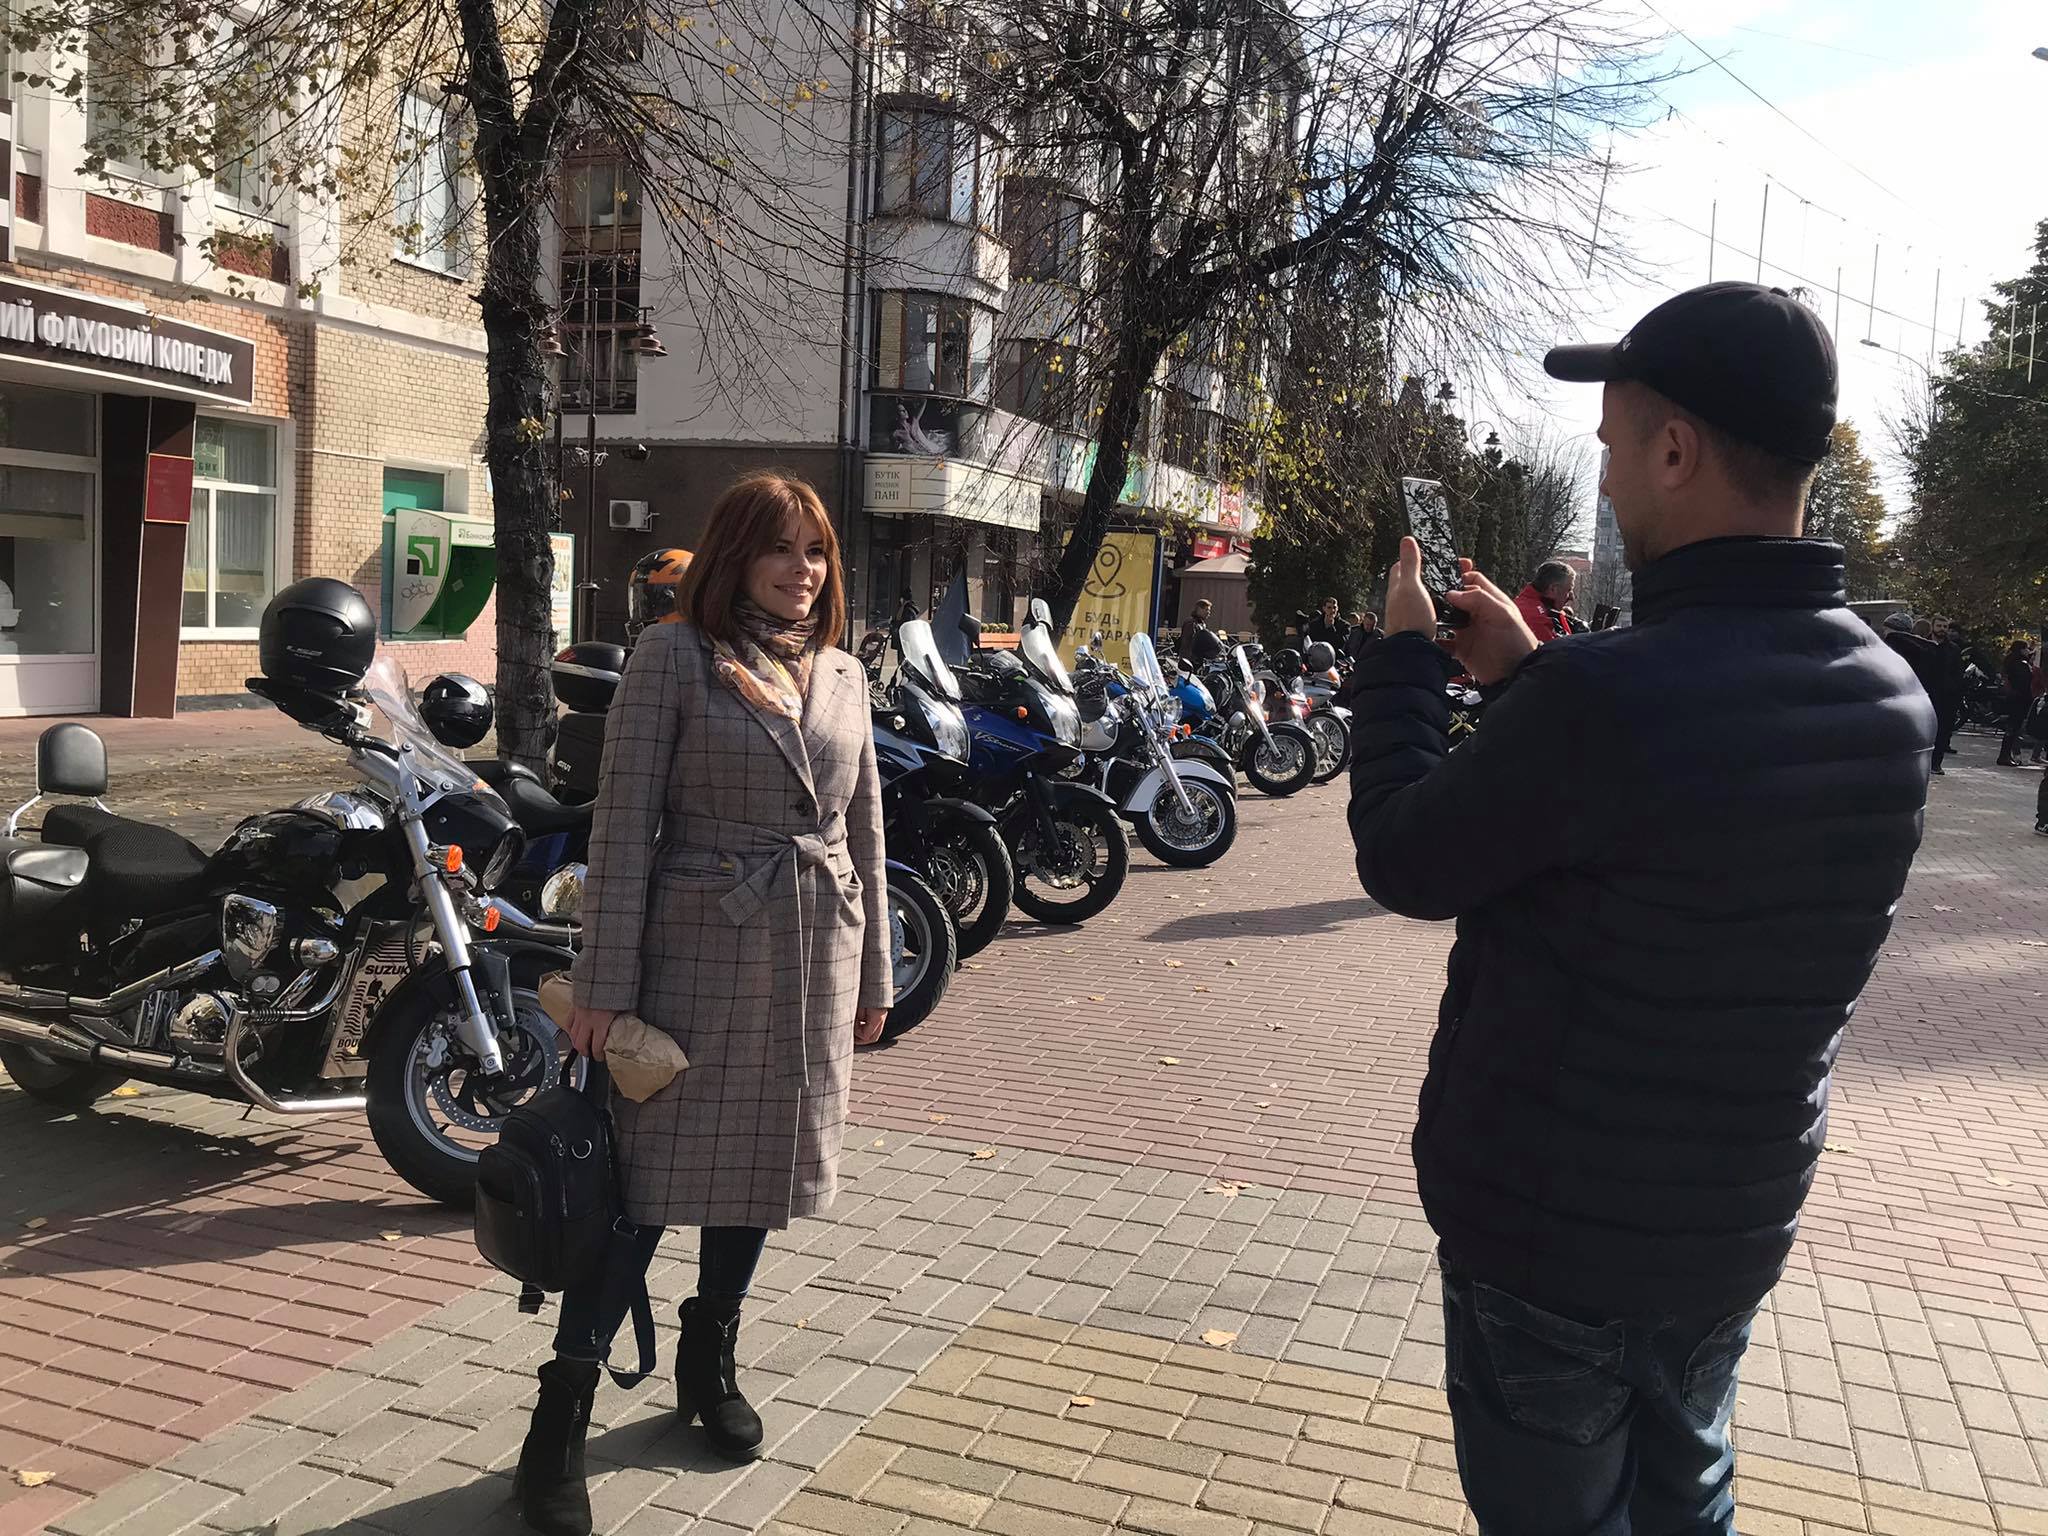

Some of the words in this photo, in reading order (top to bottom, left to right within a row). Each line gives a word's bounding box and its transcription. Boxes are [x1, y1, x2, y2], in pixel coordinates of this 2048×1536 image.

[39, 311, 153, 366] ФАХОВИЙ
[155, 335, 233, 385] КОЛЕДЖ
[874, 471, 900, 480] БУТІК
[874, 490, 900, 500] ПАНІ
[1085, 611, 1120, 627] БУДЬ
[1098, 629, 1132, 641] ЗАРА
[364, 964, 410, 975] SUZUK
[336, 1039, 359, 1048] BOU
